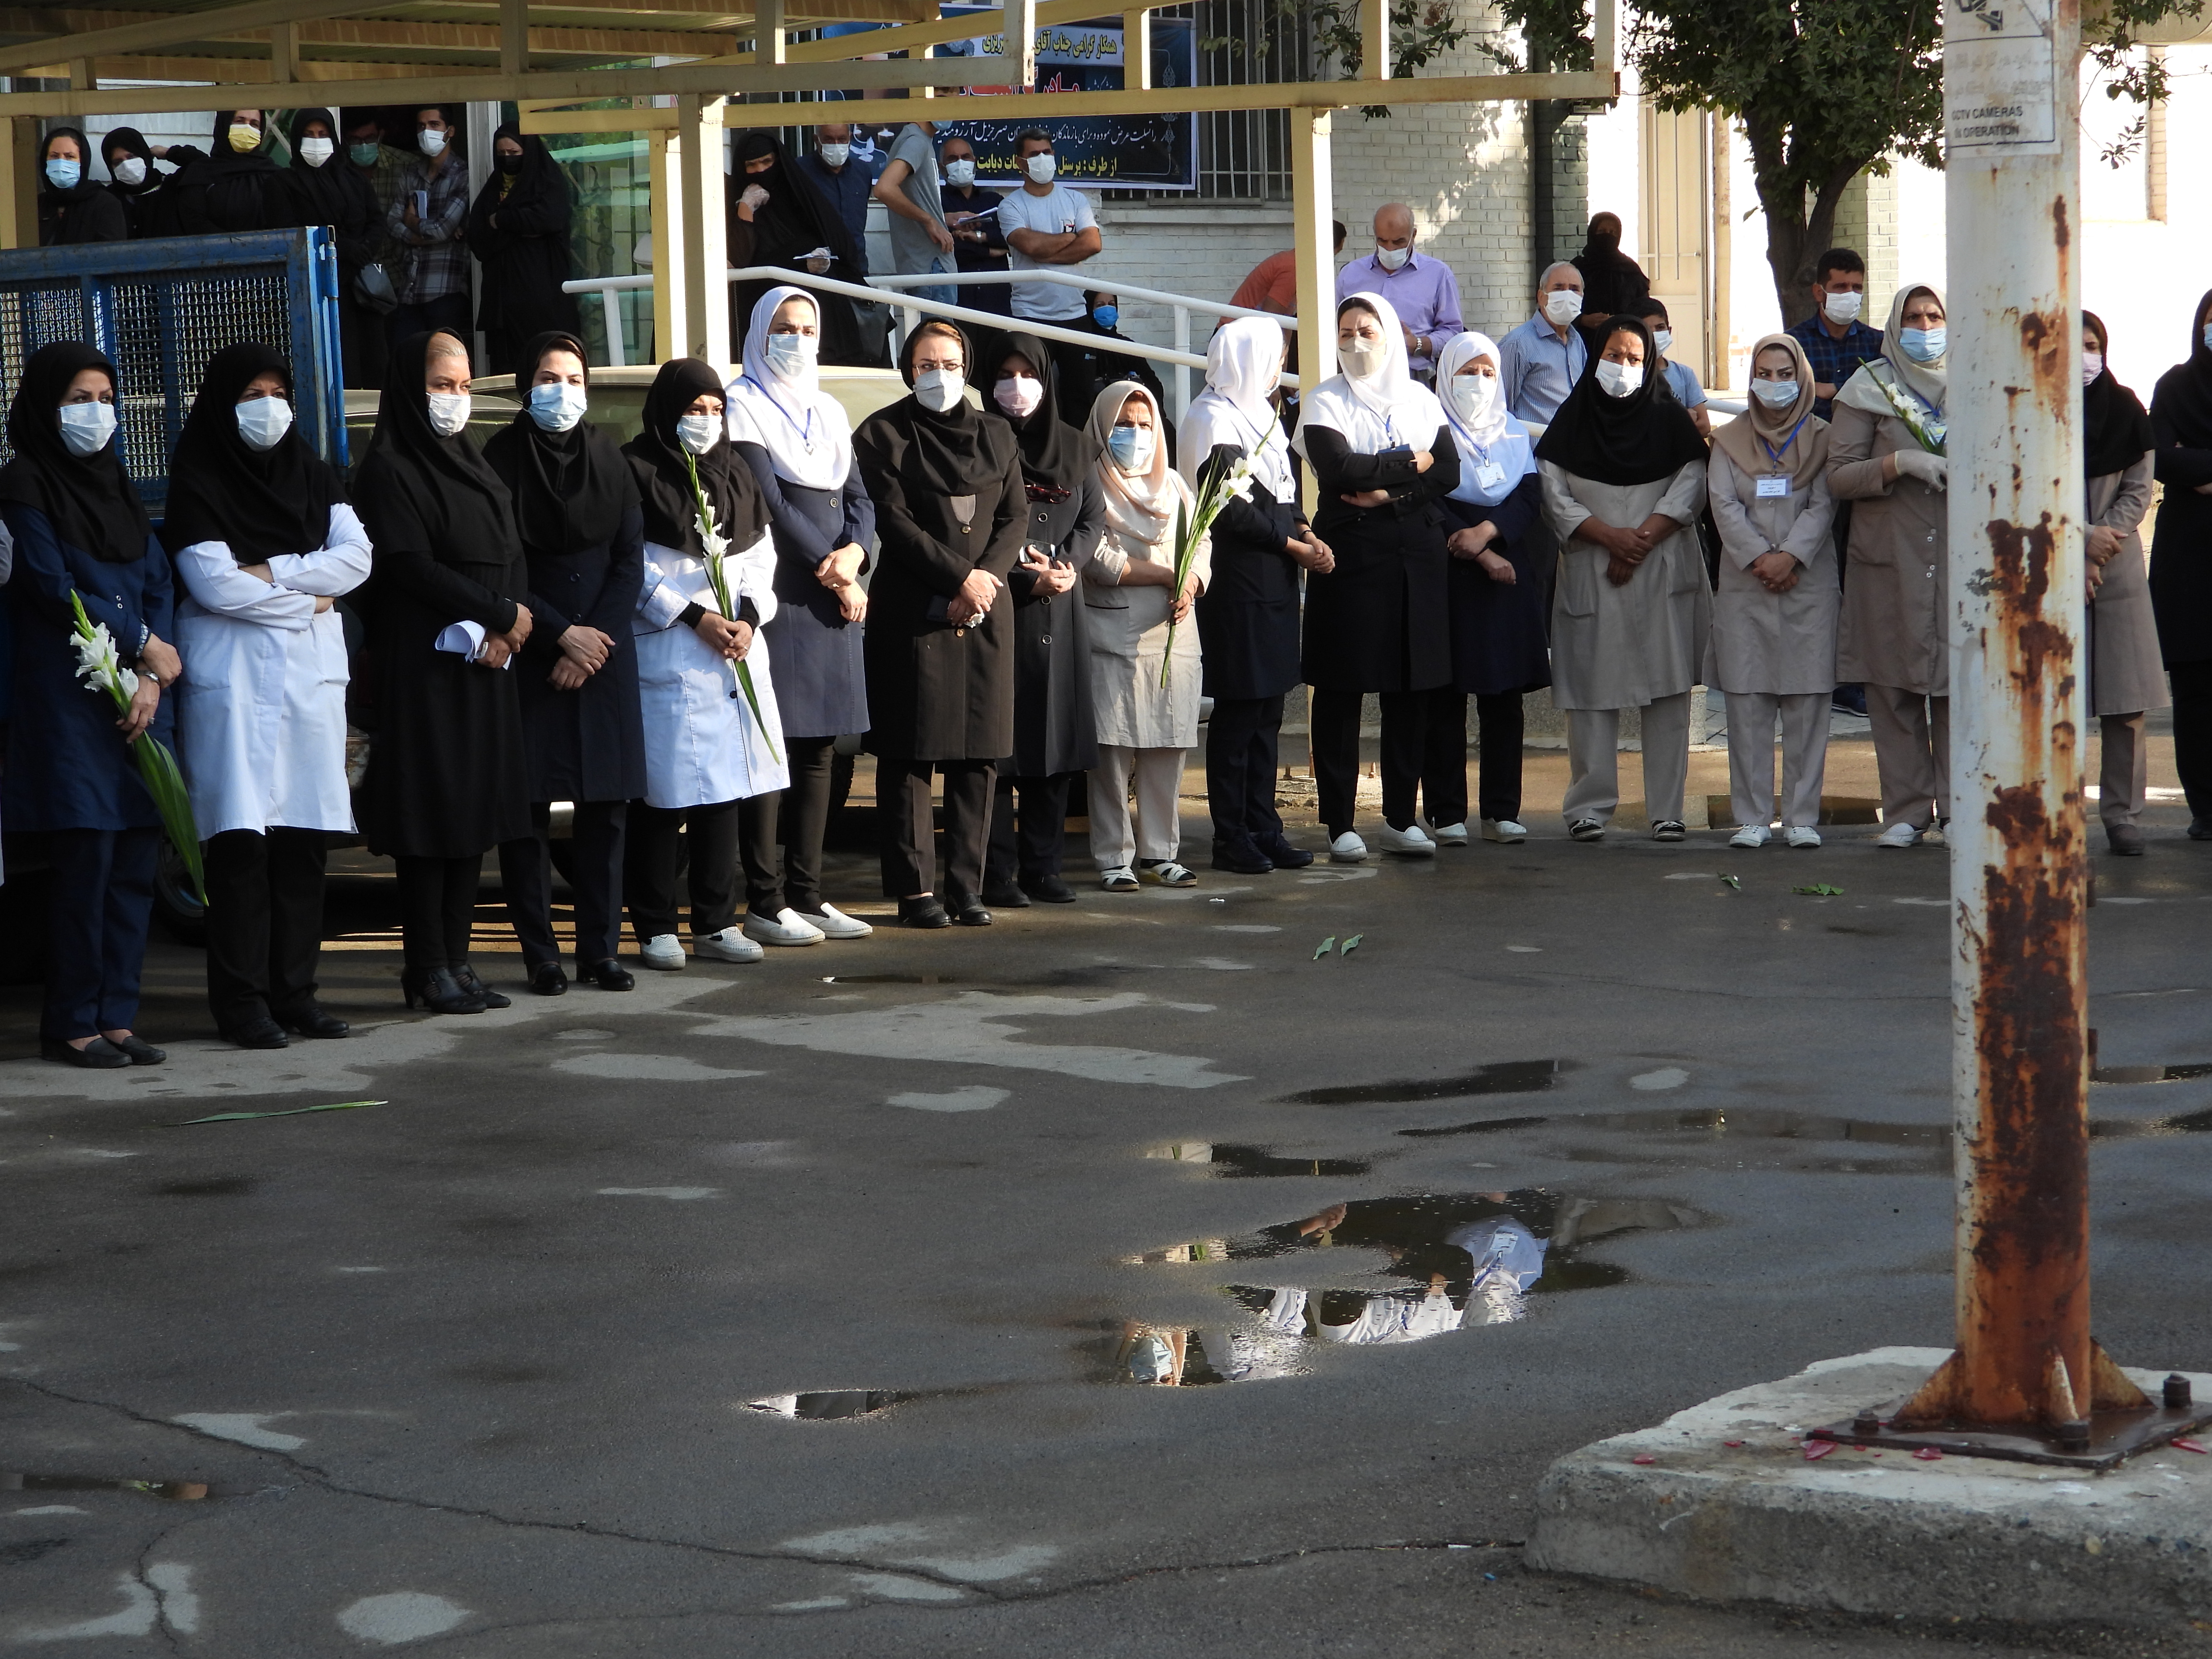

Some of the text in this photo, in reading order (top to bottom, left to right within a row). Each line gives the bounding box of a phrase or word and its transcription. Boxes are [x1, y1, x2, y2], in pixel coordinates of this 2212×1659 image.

[1034, 29, 1051, 56] آقای
[1053, 32, 1071, 57] جناب
[1073, 33, 1095, 58] گرامی
[1096, 35, 1117, 59] همکار
[1951, 105, 2023, 120] CCTV CAMERAS
[974, 121, 995, 142] جزیل
[992, 125, 1008, 146] صبر
[1078, 127, 1093, 148] برای
[1111, 126, 1130, 144] عرض
[1130, 120, 1152, 149] تسلیت
[1963, 124, 2020, 138] OPERATION
[977, 153, 1002, 173] دیابت
[1058, 156, 1081, 177] پرسنل
[1088, 156, 1108, 177] طرف
[1110, 157, 1117, 177] از
